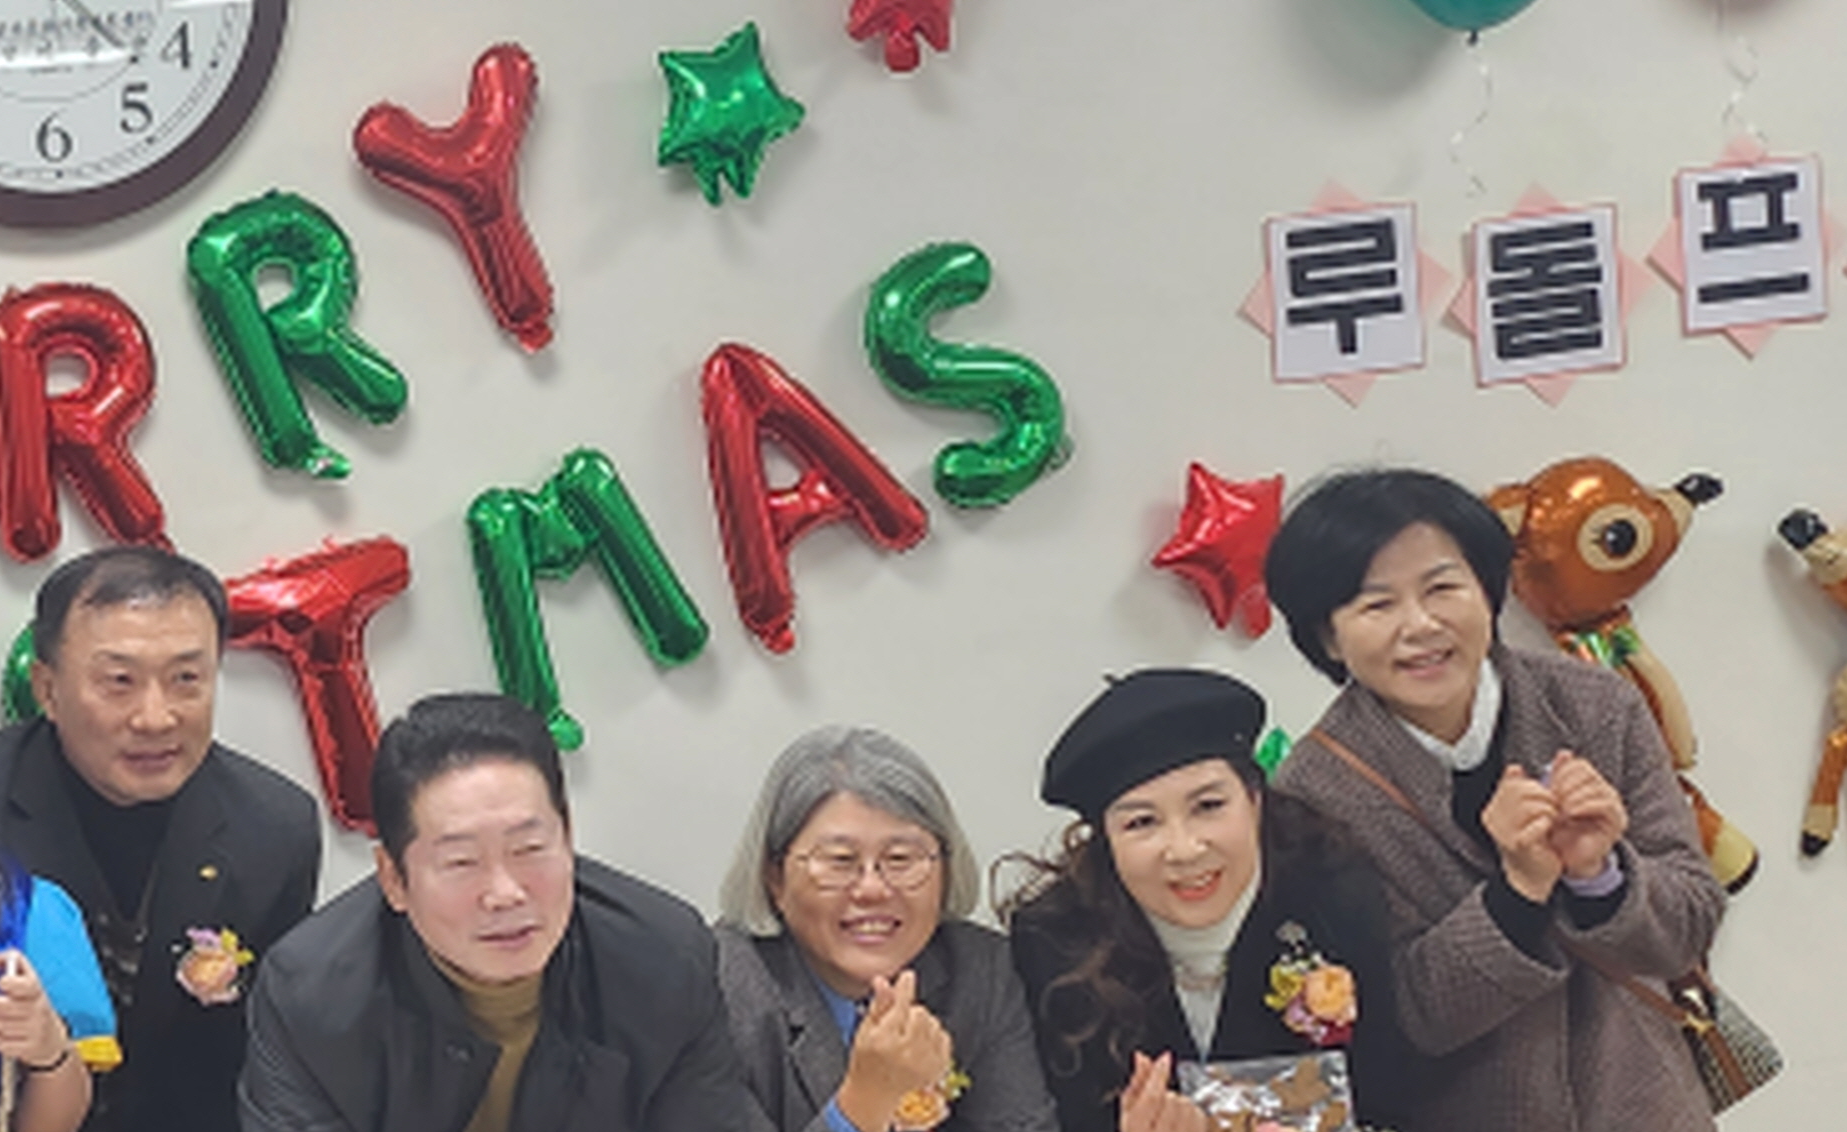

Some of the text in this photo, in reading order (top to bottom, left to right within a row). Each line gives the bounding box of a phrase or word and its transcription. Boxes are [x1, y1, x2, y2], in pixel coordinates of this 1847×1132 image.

[160, 23, 194, 71] 4
[120, 84, 153, 134] 5
[36, 114, 73, 163] 6
[1285, 172, 1810, 360] 루돌프
